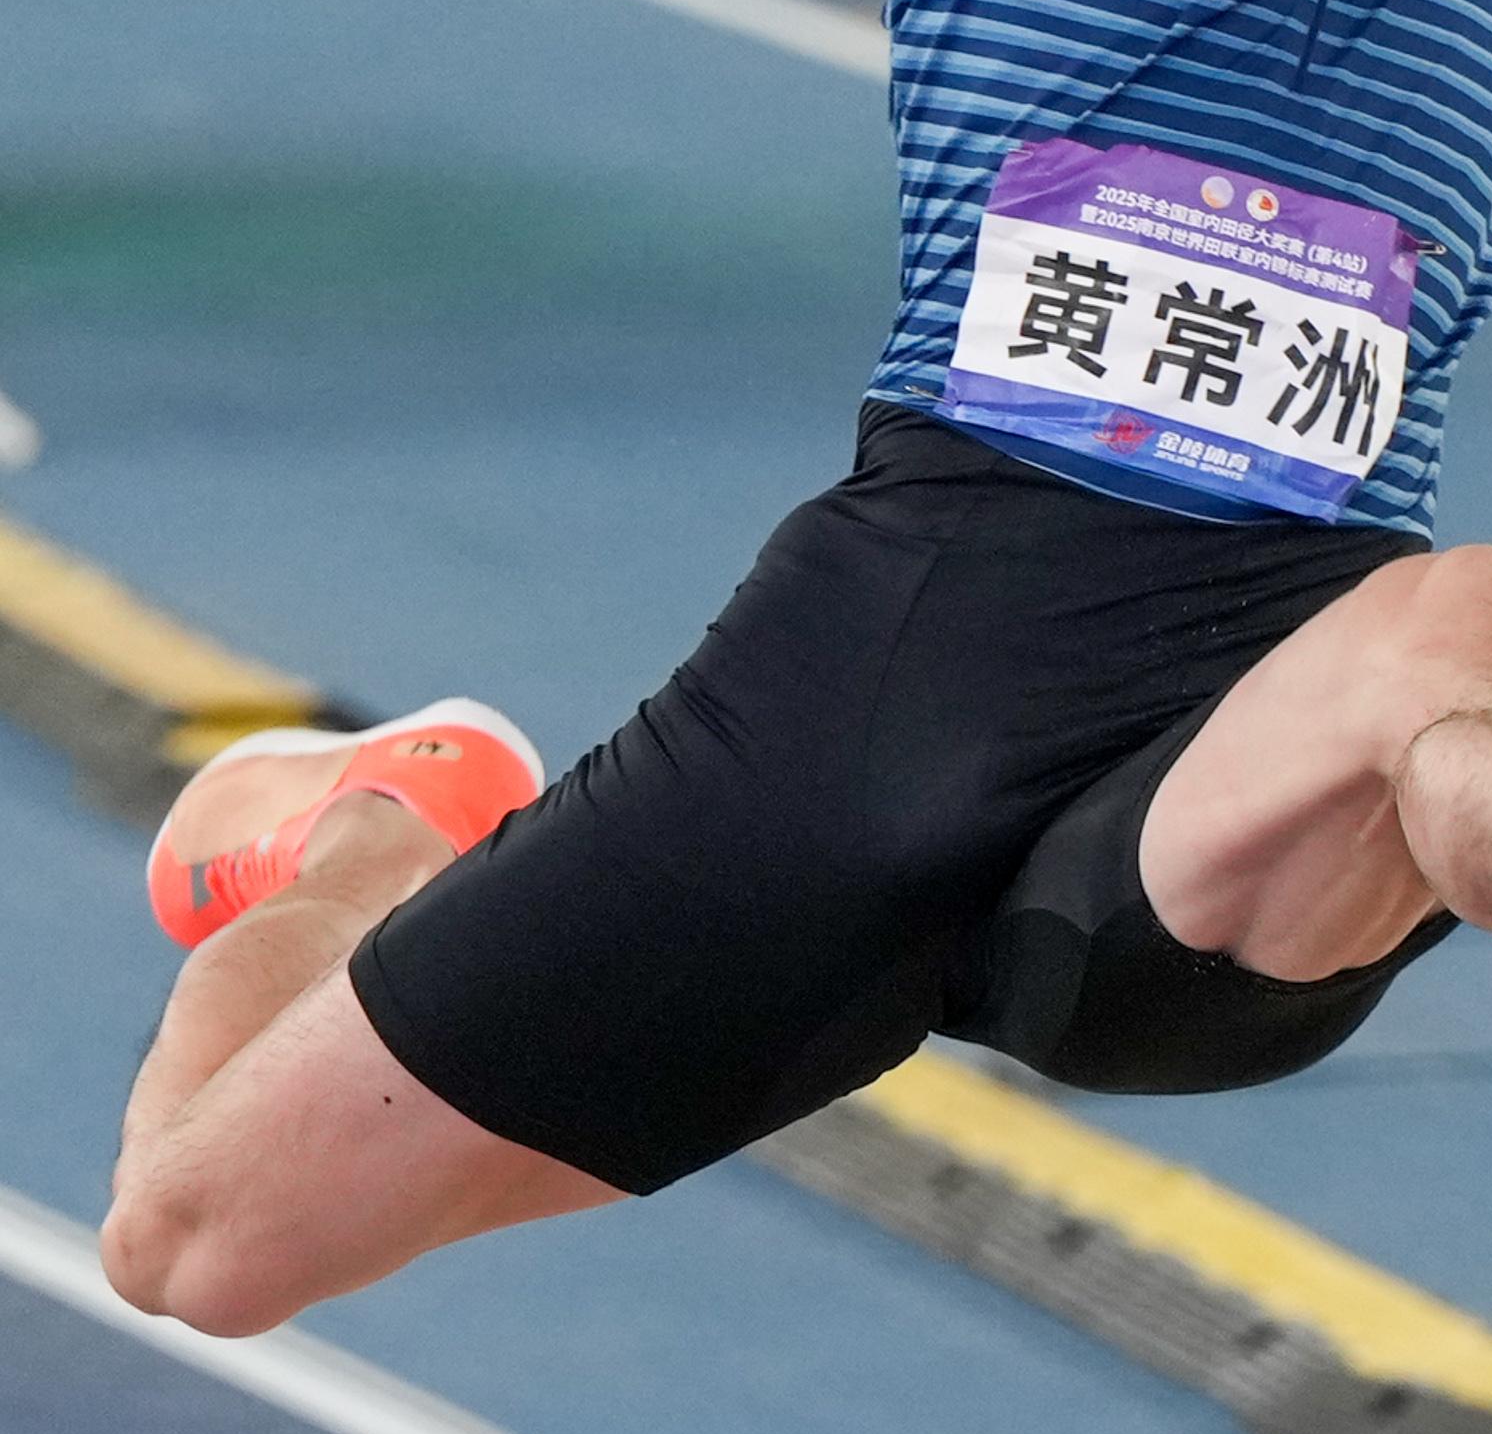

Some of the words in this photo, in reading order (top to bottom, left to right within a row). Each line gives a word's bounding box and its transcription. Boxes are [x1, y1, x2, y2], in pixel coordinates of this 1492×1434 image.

[1008, 251, 1381, 457] 黄常洲
[1155, 430, 1252, 473] 金陵体育
